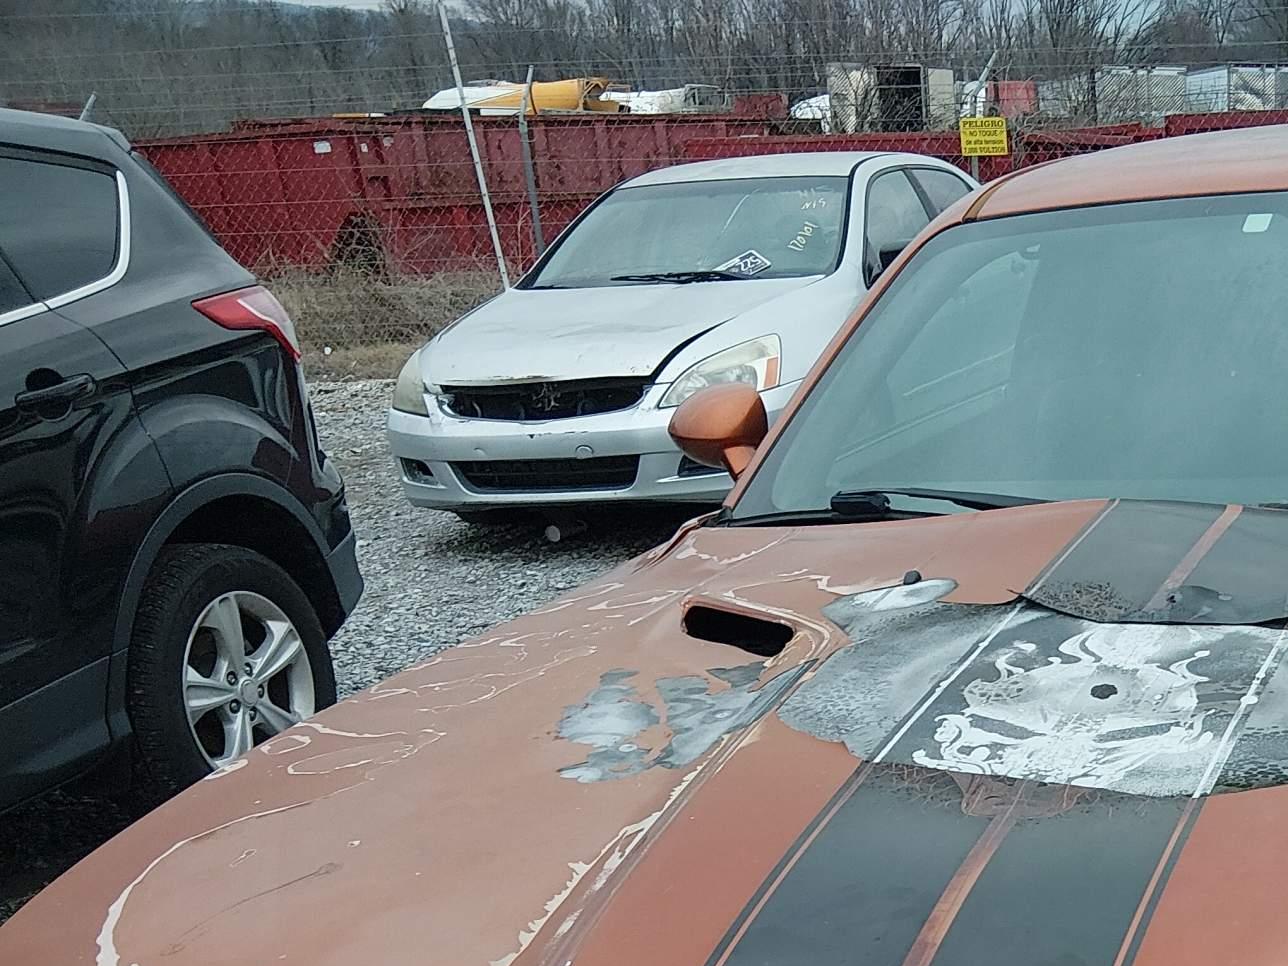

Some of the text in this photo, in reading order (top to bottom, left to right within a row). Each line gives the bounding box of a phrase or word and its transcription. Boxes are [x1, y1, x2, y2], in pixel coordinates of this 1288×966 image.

[962, 120, 1004, 128] PELIGRO
[978, 129, 998, 137] TOQUE
[735, 255, 762, 272] 225
